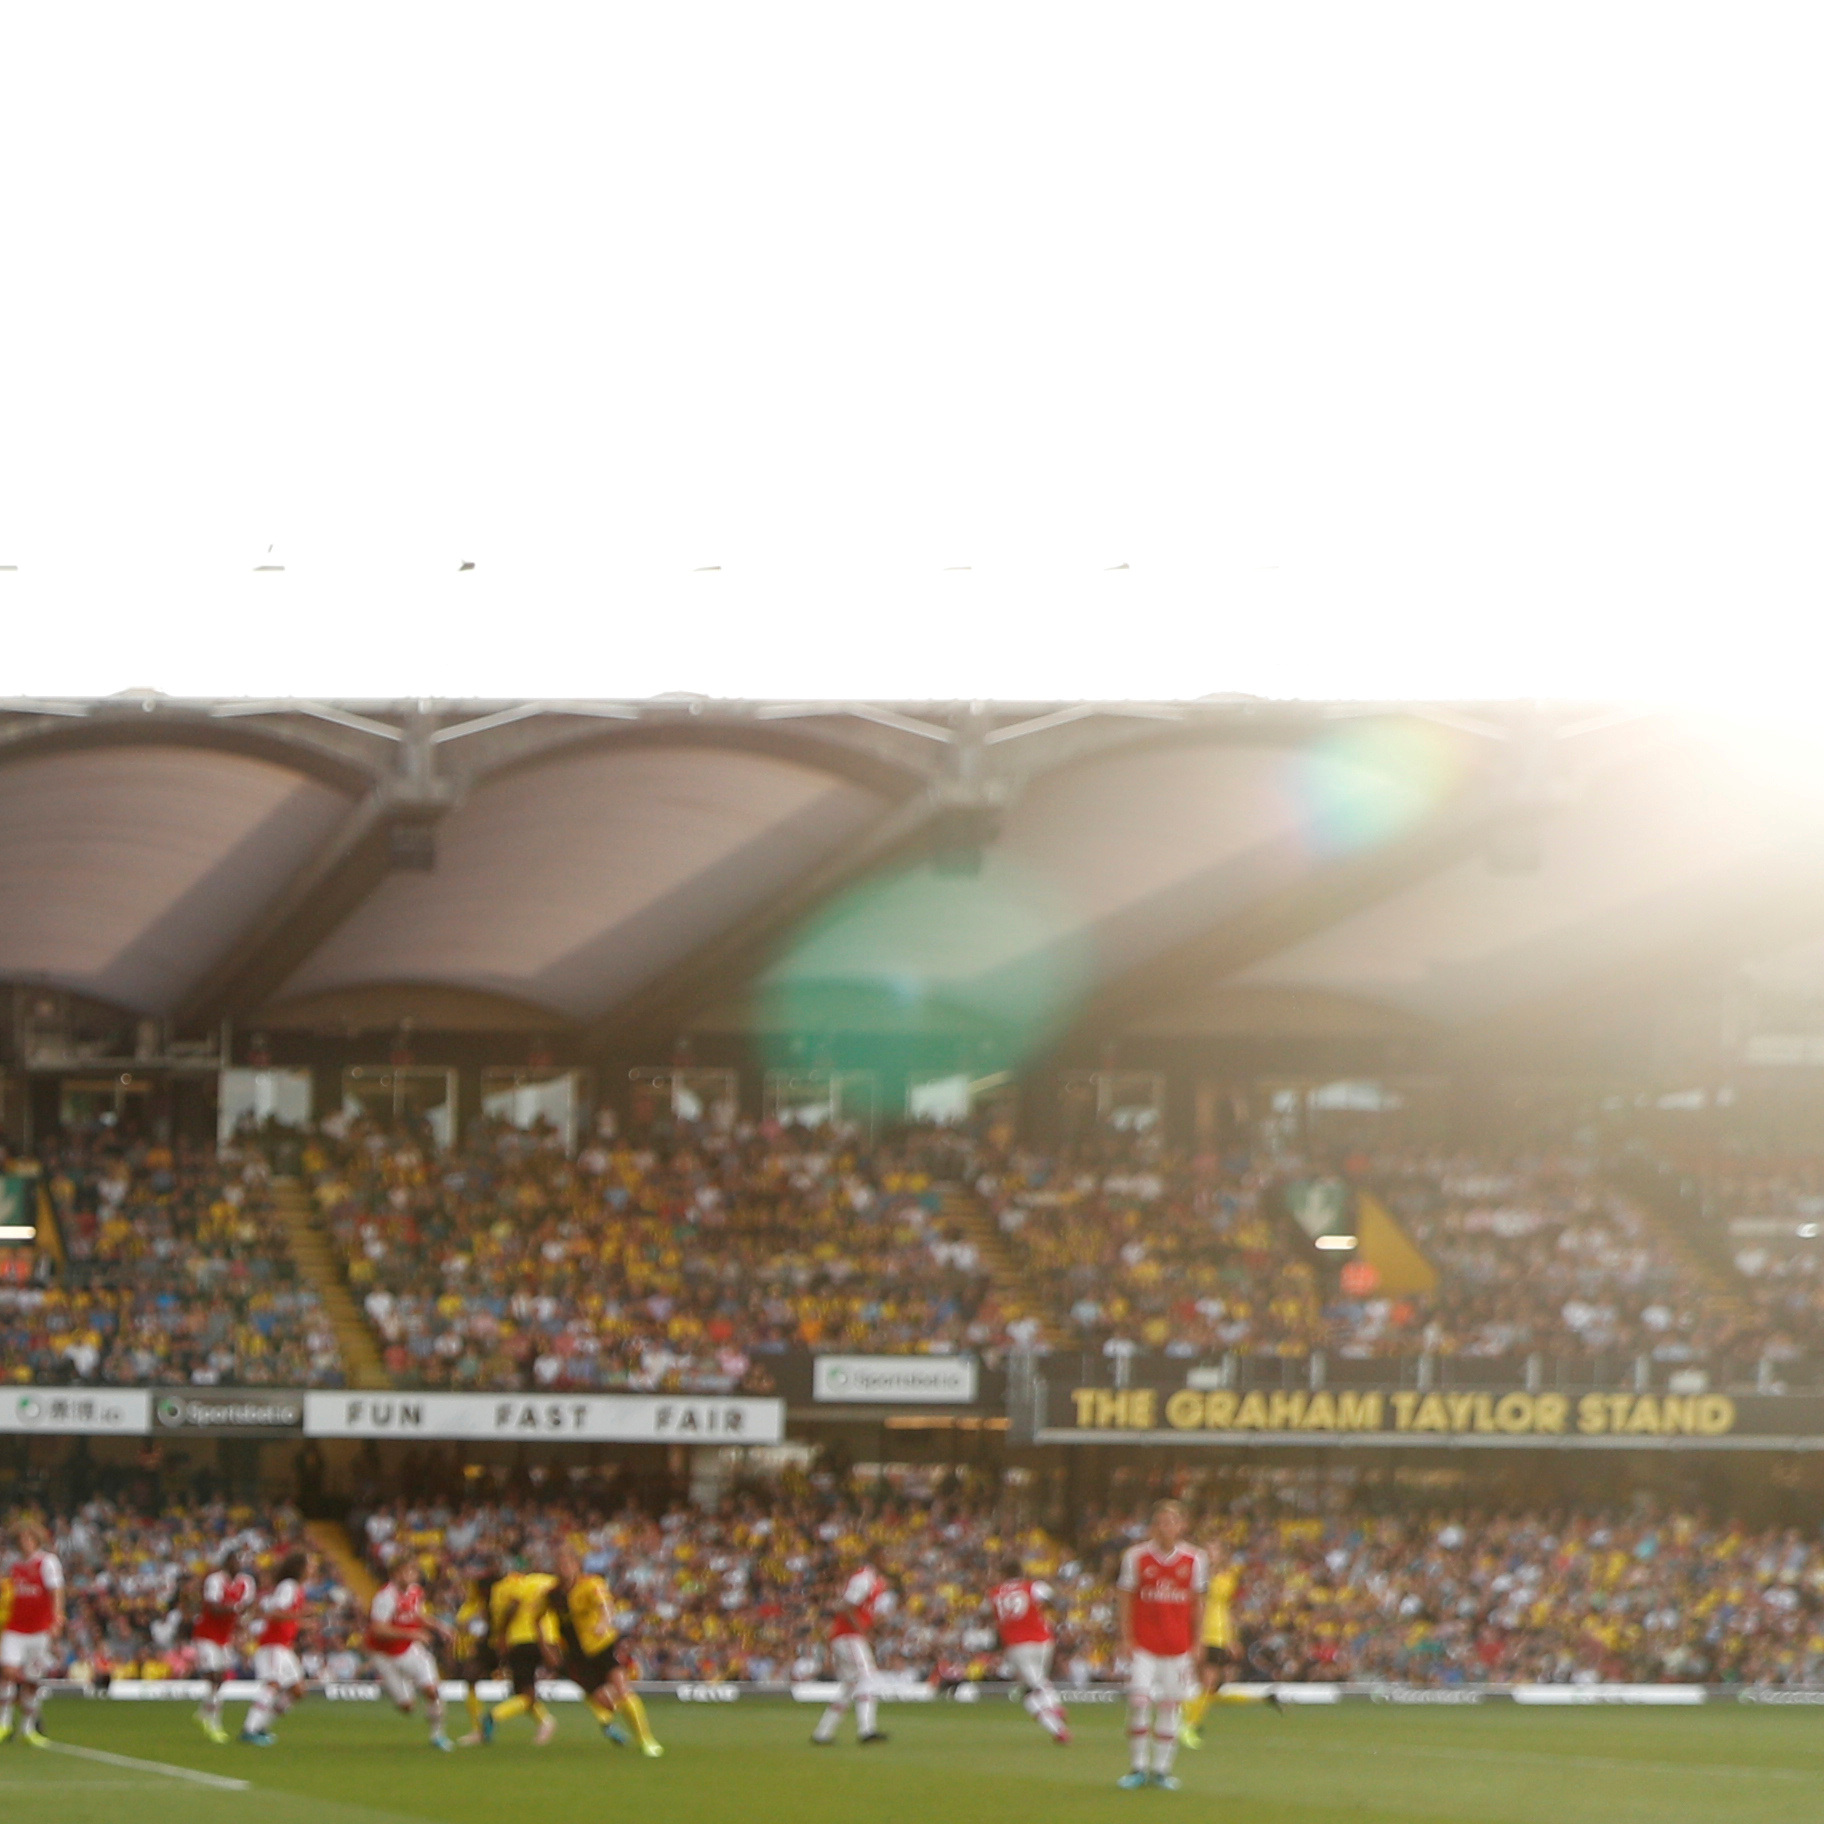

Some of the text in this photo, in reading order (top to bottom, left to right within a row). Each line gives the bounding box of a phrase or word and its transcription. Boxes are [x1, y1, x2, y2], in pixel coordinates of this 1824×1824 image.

[346, 1401, 744, 1432] FUN FAST FAIR
[1071, 1388, 1736, 1434] THE GRAHAM TAYLOR STAND
